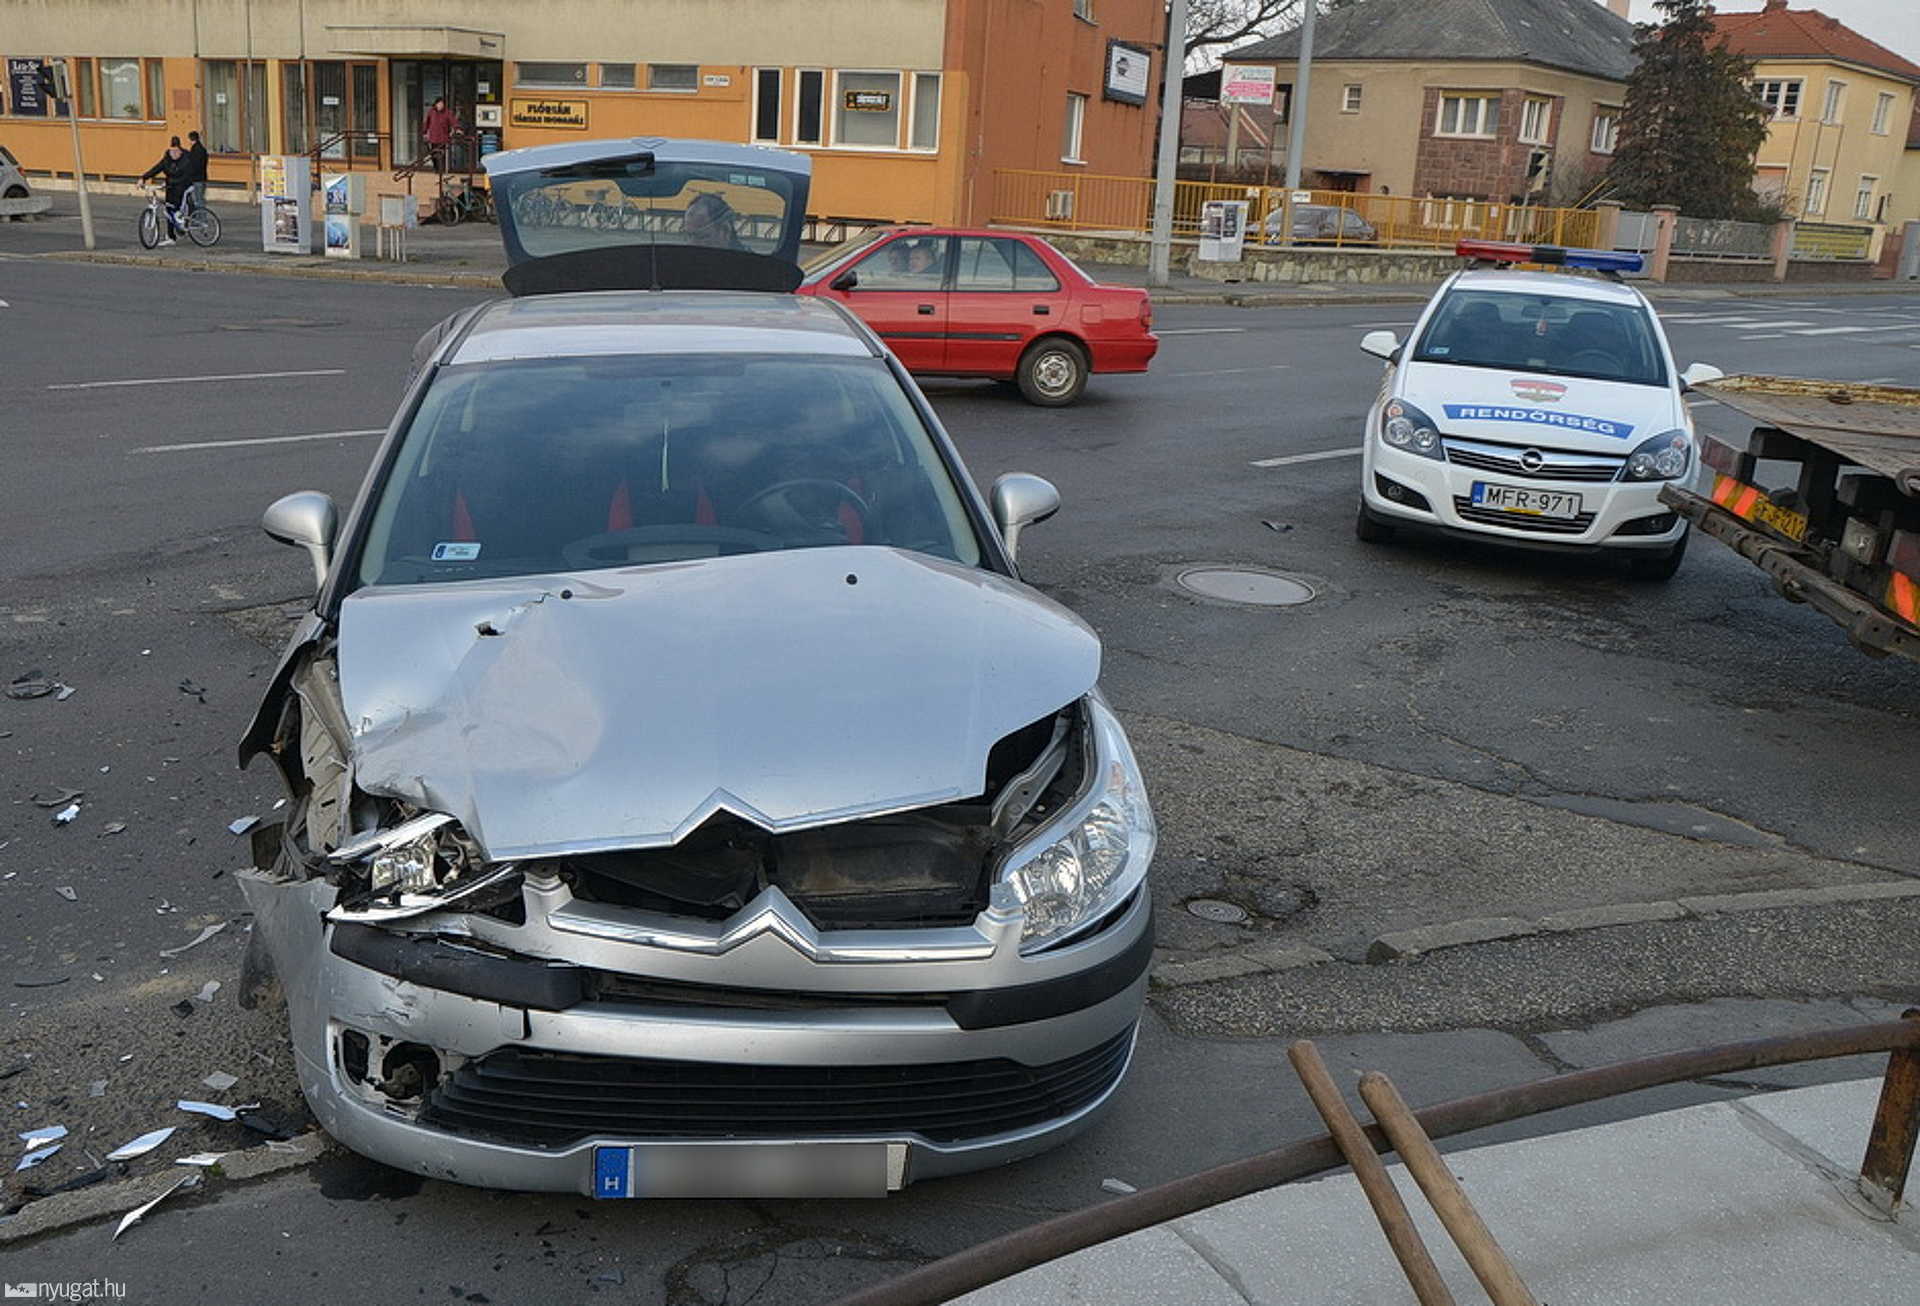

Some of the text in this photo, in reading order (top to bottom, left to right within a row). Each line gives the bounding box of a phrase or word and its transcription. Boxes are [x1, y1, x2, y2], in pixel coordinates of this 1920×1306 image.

[1459, 408, 1616, 434] RENDŐRSÉG
[1486, 488, 1574, 514] MFR-971
[604, 1176, 620, 1191] H
